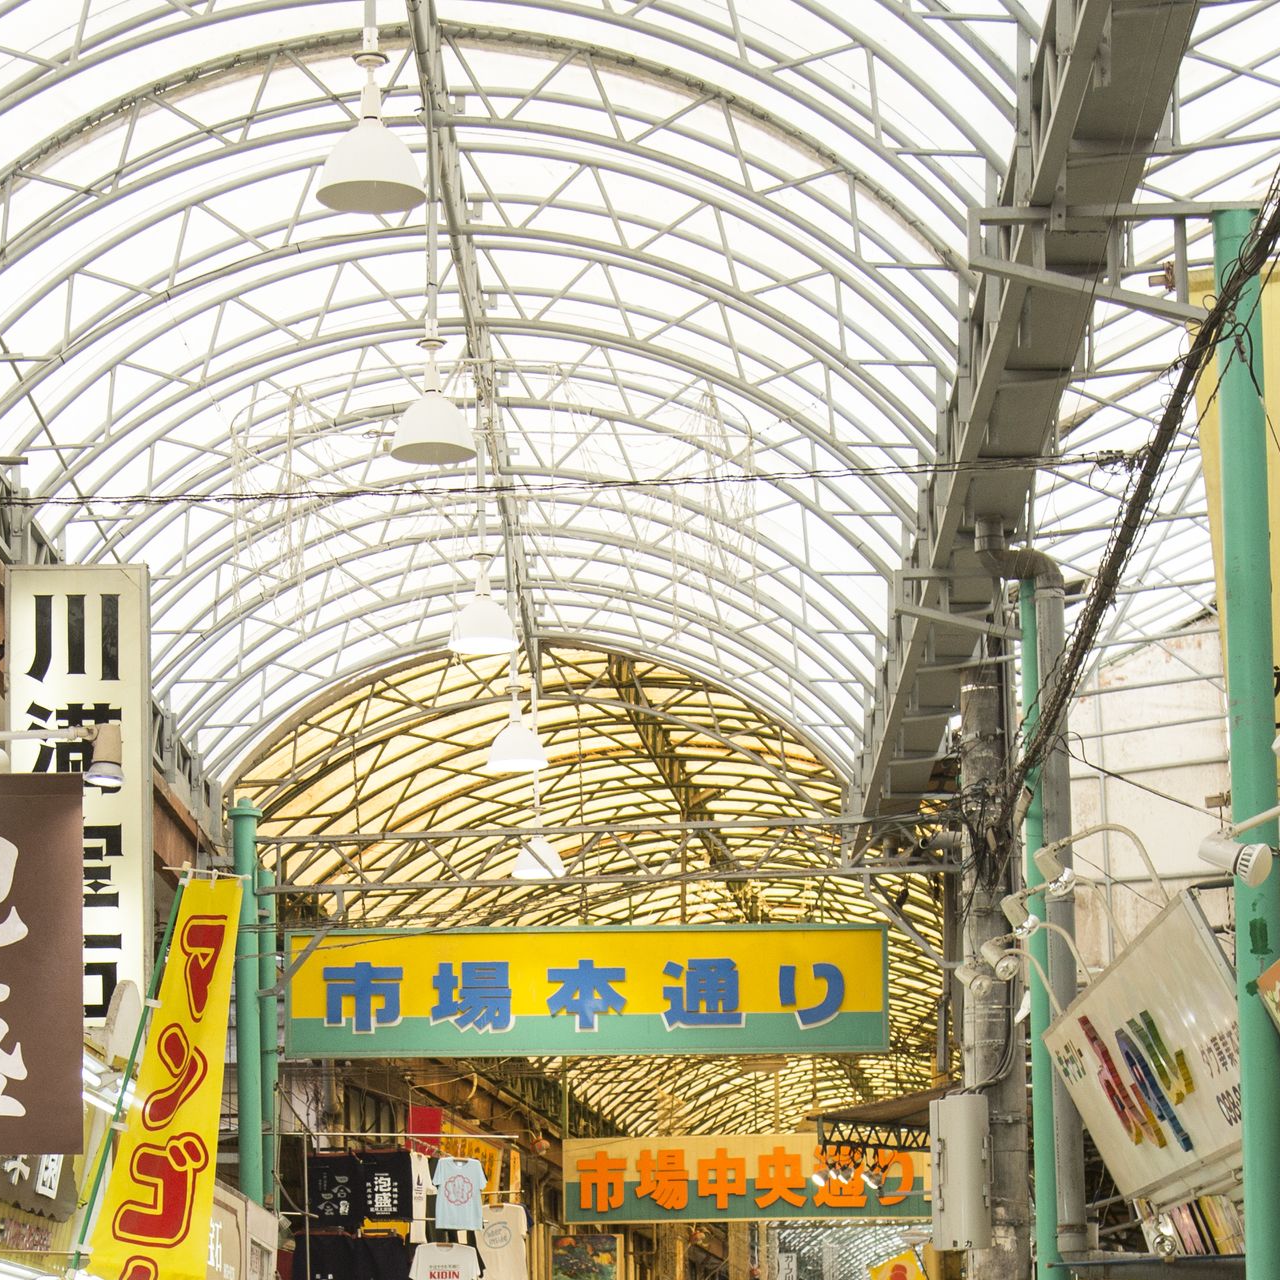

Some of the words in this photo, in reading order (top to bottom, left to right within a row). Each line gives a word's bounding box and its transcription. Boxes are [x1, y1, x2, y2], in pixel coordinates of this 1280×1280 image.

[321, 957, 848, 1035] 市場本通り
[373, 1176, 392, 1208] 泡盛
[577, 1146, 917, 1214] 市場中央通り
